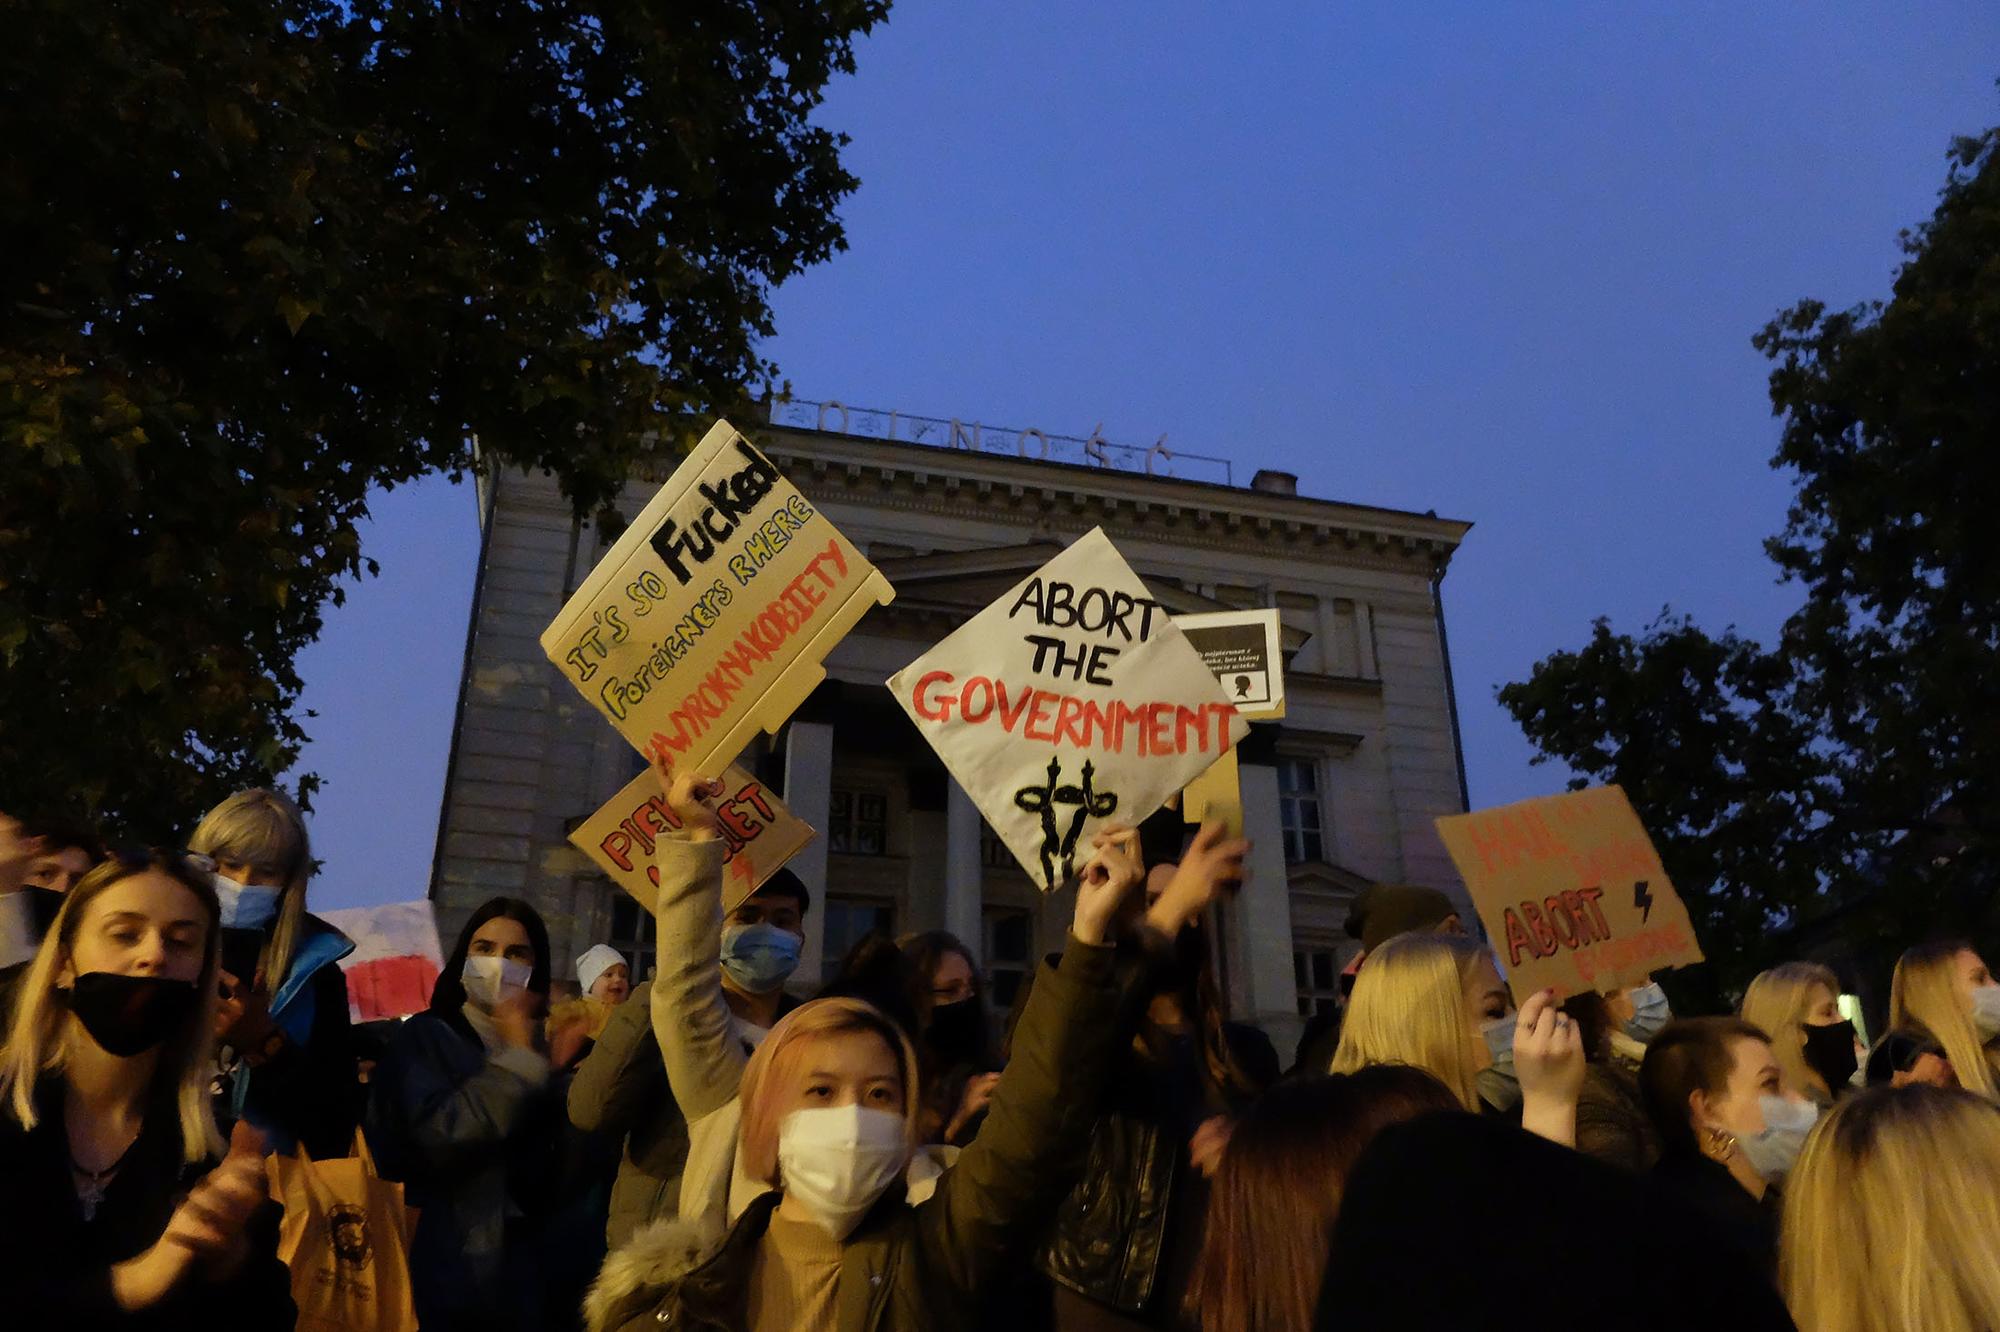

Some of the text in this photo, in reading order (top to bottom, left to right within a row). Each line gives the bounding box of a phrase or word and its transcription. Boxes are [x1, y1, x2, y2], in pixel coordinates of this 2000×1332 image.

[566, 439, 782, 682] IT'S SO Fucked
[1009, 577, 1162, 642] ABORT
[1023, 634, 1120, 687] THE
[912, 671, 1240, 758] GOVERNMENT
[1504, 888, 1611, 967] ABORT
